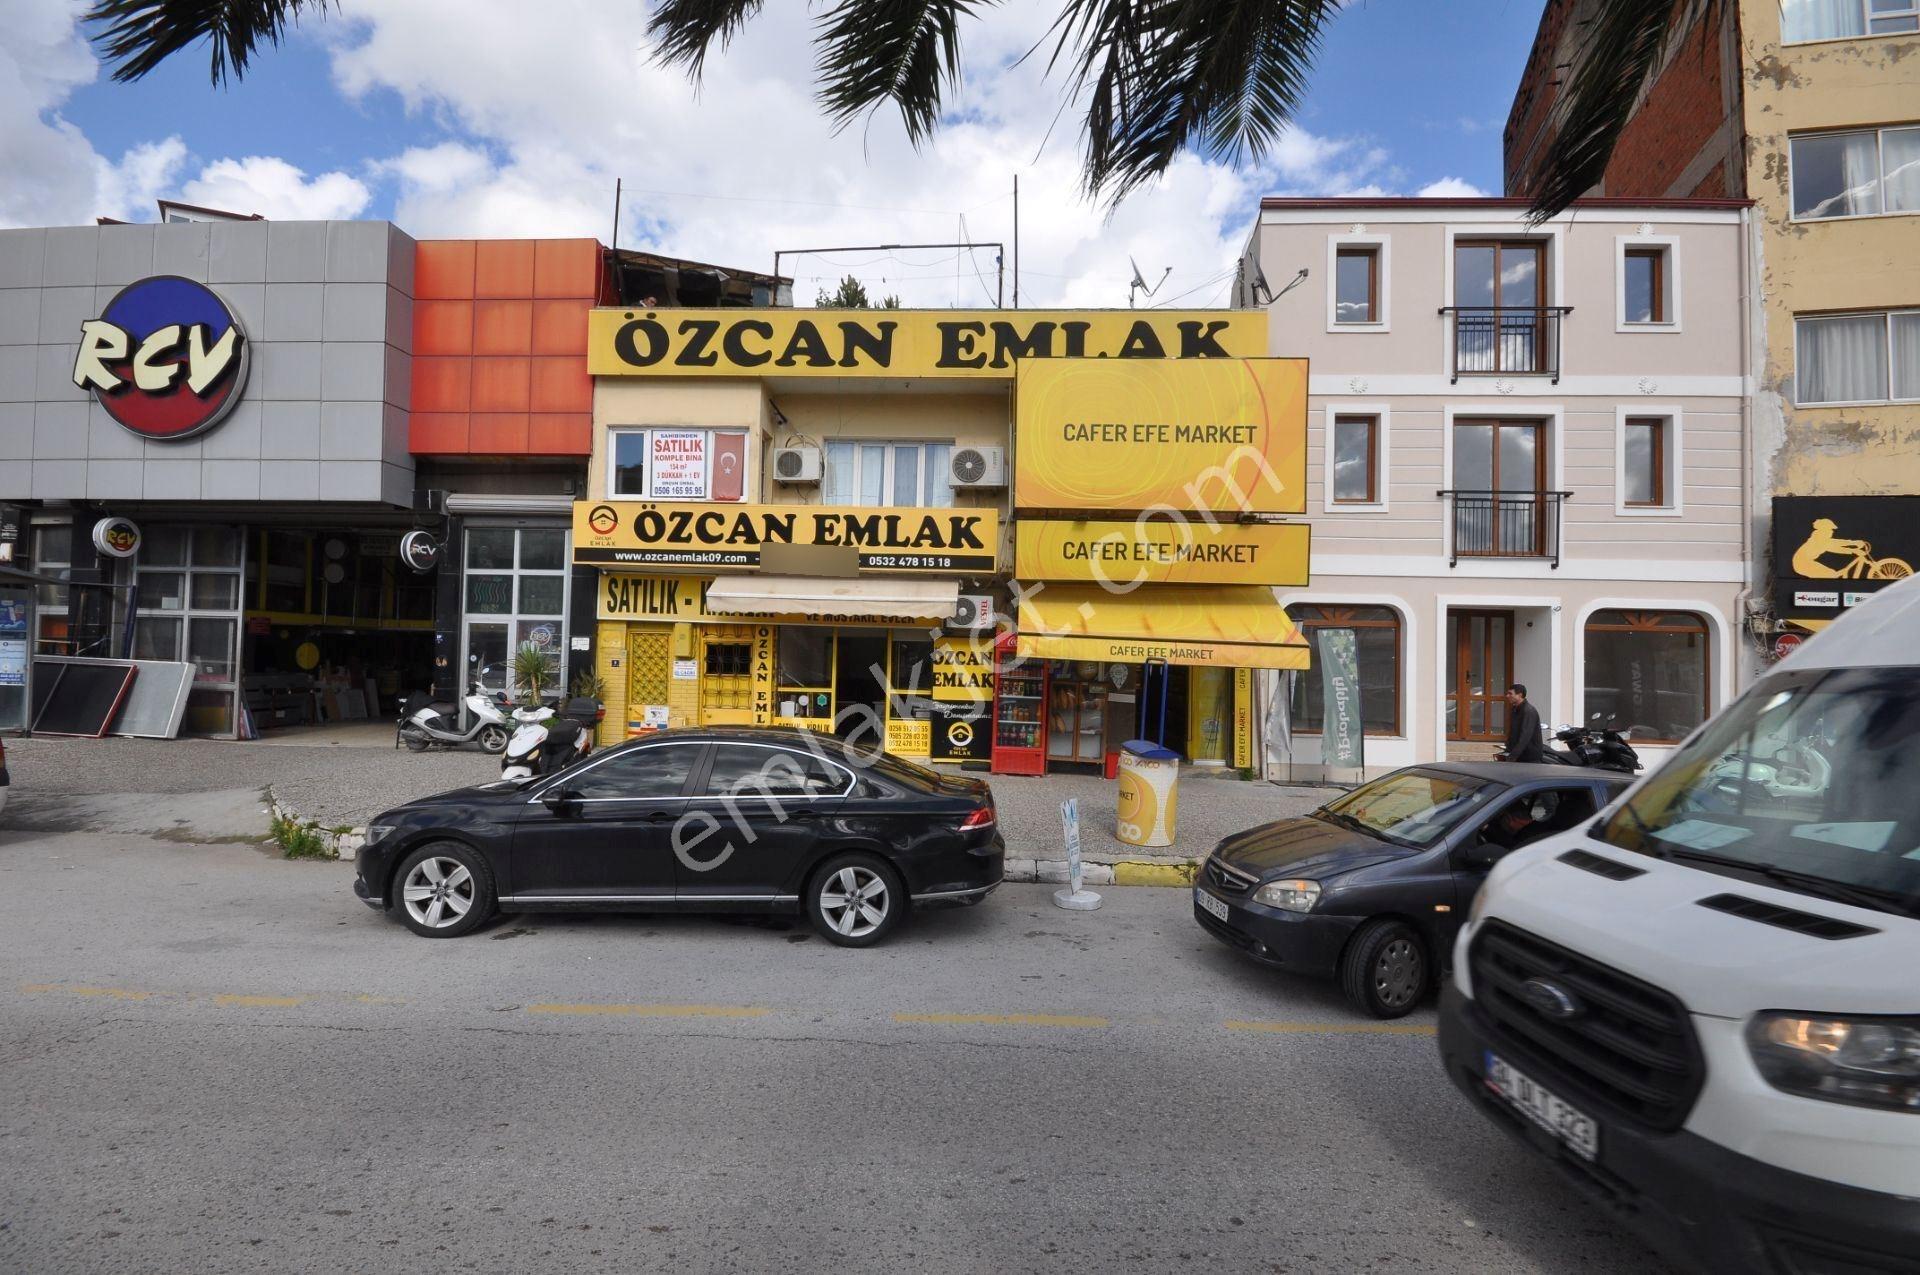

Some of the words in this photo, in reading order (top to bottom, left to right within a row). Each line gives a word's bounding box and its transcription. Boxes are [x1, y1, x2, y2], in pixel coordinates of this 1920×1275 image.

[615, 312, 898, 368] ÖZCAN
[935, 320, 1232, 369] EMLAK
[73, 319, 242, 397] RCV
[1063, 423, 1127, 442] CAFER
[1133, 424, 1170, 443] EFE
[1175, 425, 1258, 444] MARKET
[654, 439, 703, 453] SATILIK
[654, 454, 684, 462] KOMPLE
[693, 471, 701, 479] EV
[671, 486, 683, 495] 165
[684, 486, 693, 495] 95
[694, 486, 703, 495] 95
[106, 528, 137, 546] RCV
[633, 504, 797, 545] ÖZCAN
[812, 514, 984, 549] EMLAK
[615, 552, 747, 563] www.ozcanemlak09.com
[869, 556, 895, 566] 0532
[898, 557, 919, 567] 478
[922, 557, 935, 567] 15
[938, 558, 951, 568] 18
[1063, 541, 1127, 561] CAFER
[1133, 542, 1171, 562] EFE
[1176, 543, 1260, 563] MARKET
[606, 577, 680, 615] SATILIK
[980, 599, 989, 626] VESTEL
[1109, 645, 1145, 657] CAFER
[1147, 646, 1167, 658] EFE
[1169, 648, 1214, 660] MARKET
[932, 671, 994, 689] EMLAK
[755, 691, 768, 724] EML
[1238, 707, 1246, 731] MARKET
[1238, 744, 1246, 766] CAFER
